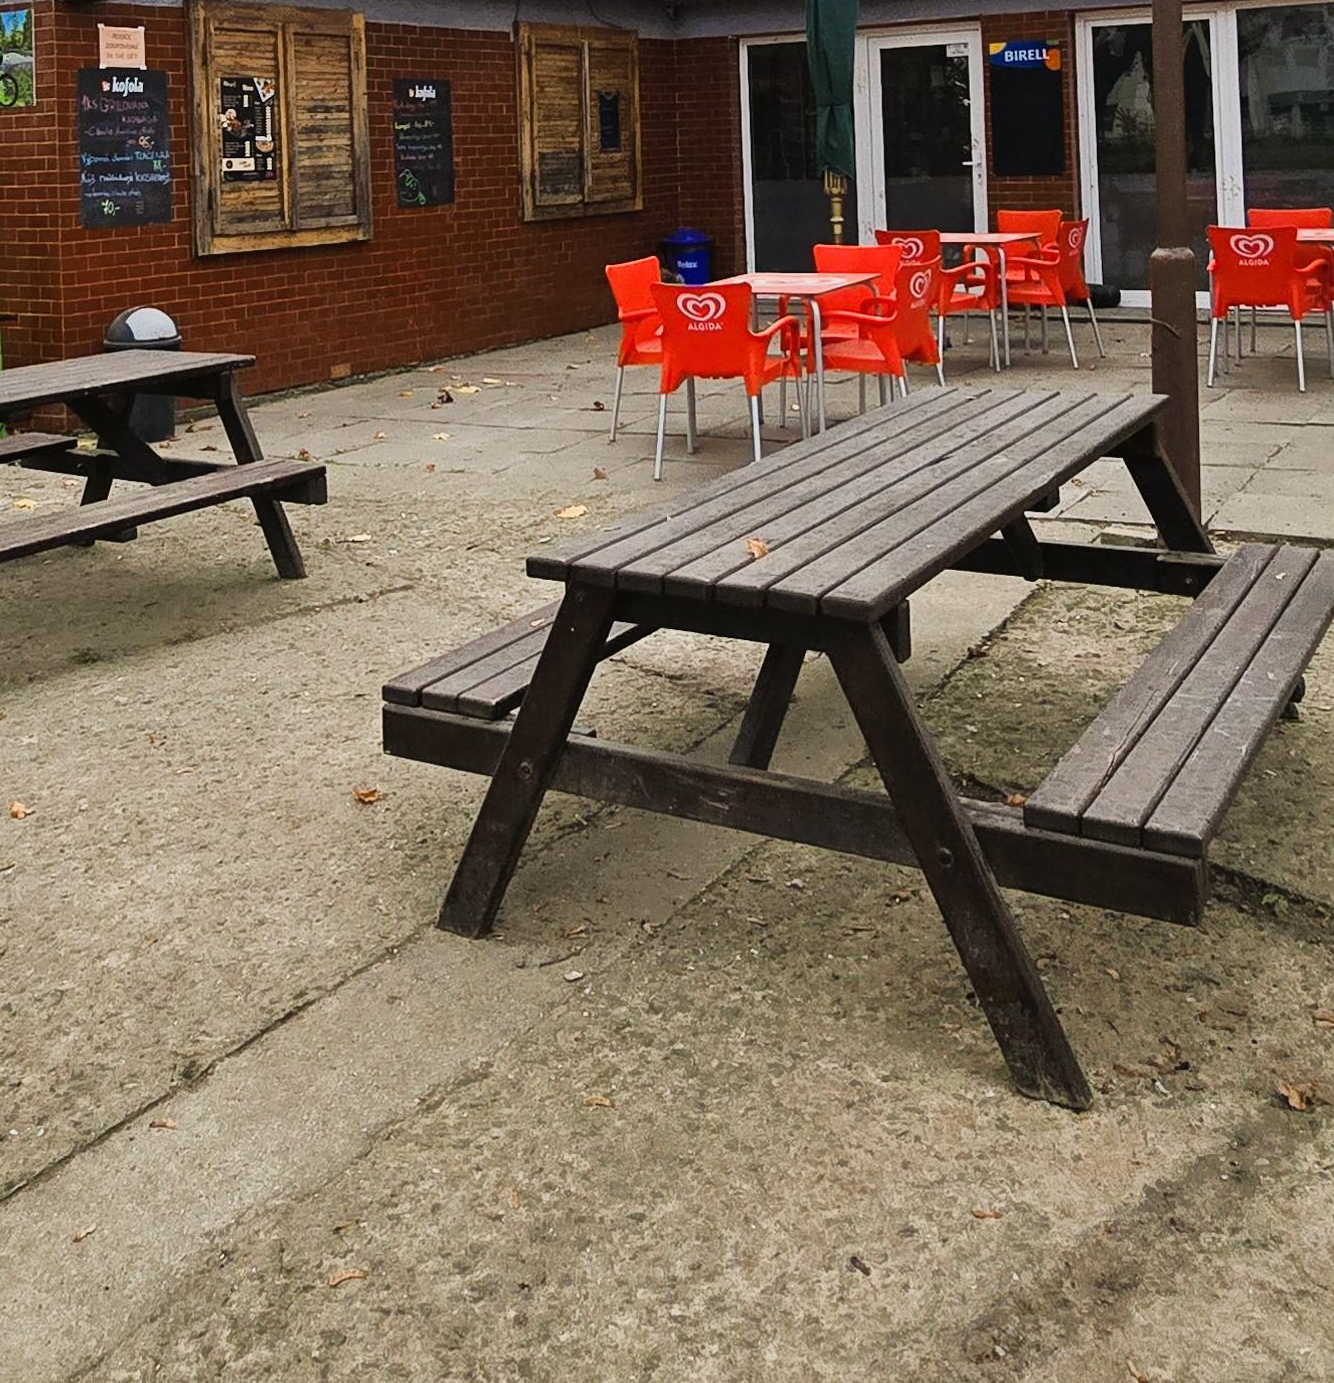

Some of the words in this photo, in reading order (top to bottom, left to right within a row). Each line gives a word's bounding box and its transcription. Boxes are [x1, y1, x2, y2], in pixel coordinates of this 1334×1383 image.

[1004, 48, 1050, 63] BIRELL
[112, 76, 144, 97] kofola
[1238, 258, 1270, 267] ALGIDA
[687, 321, 723, 331] ALGIDA
